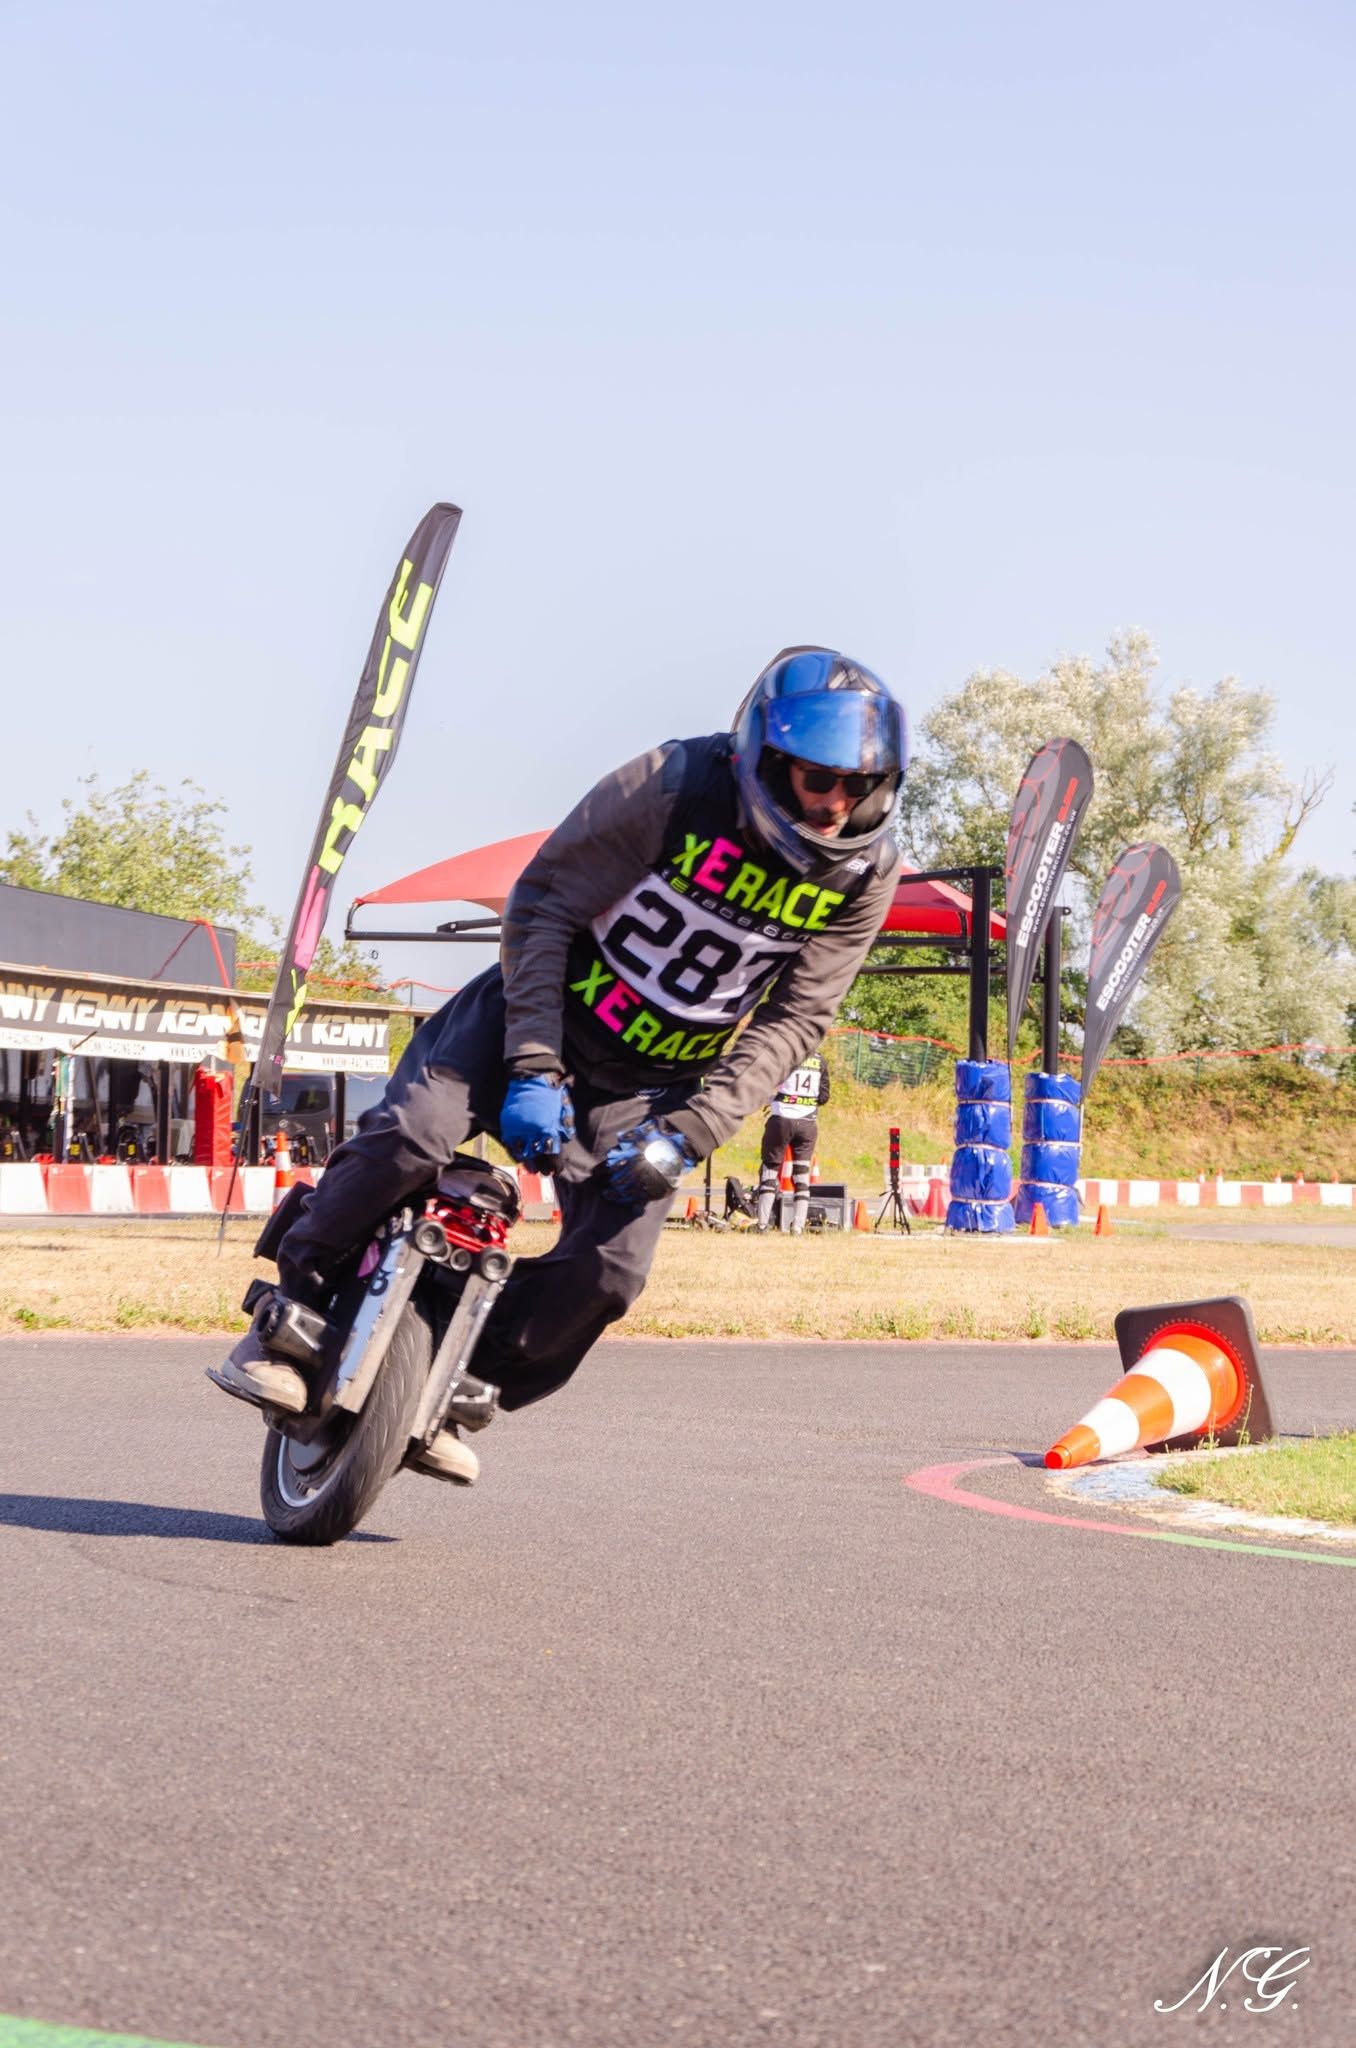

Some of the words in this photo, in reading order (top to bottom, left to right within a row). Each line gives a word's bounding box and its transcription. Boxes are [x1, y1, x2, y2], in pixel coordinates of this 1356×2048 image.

[671, 832, 846, 930] XERACE
[1016, 821, 1065, 948] ESCOOTER
[601, 889, 790, 1013] 287
[1096, 912, 1151, 1012] ESCOOTER
[0, 982, 57, 1022] NNY
[56, 988, 159, 1032] KENNY
[312, 1013, 388, 1048] KENNY
[569, 959, 733, 1061] XERACE
[795, 1073, 812, 1093] 14
